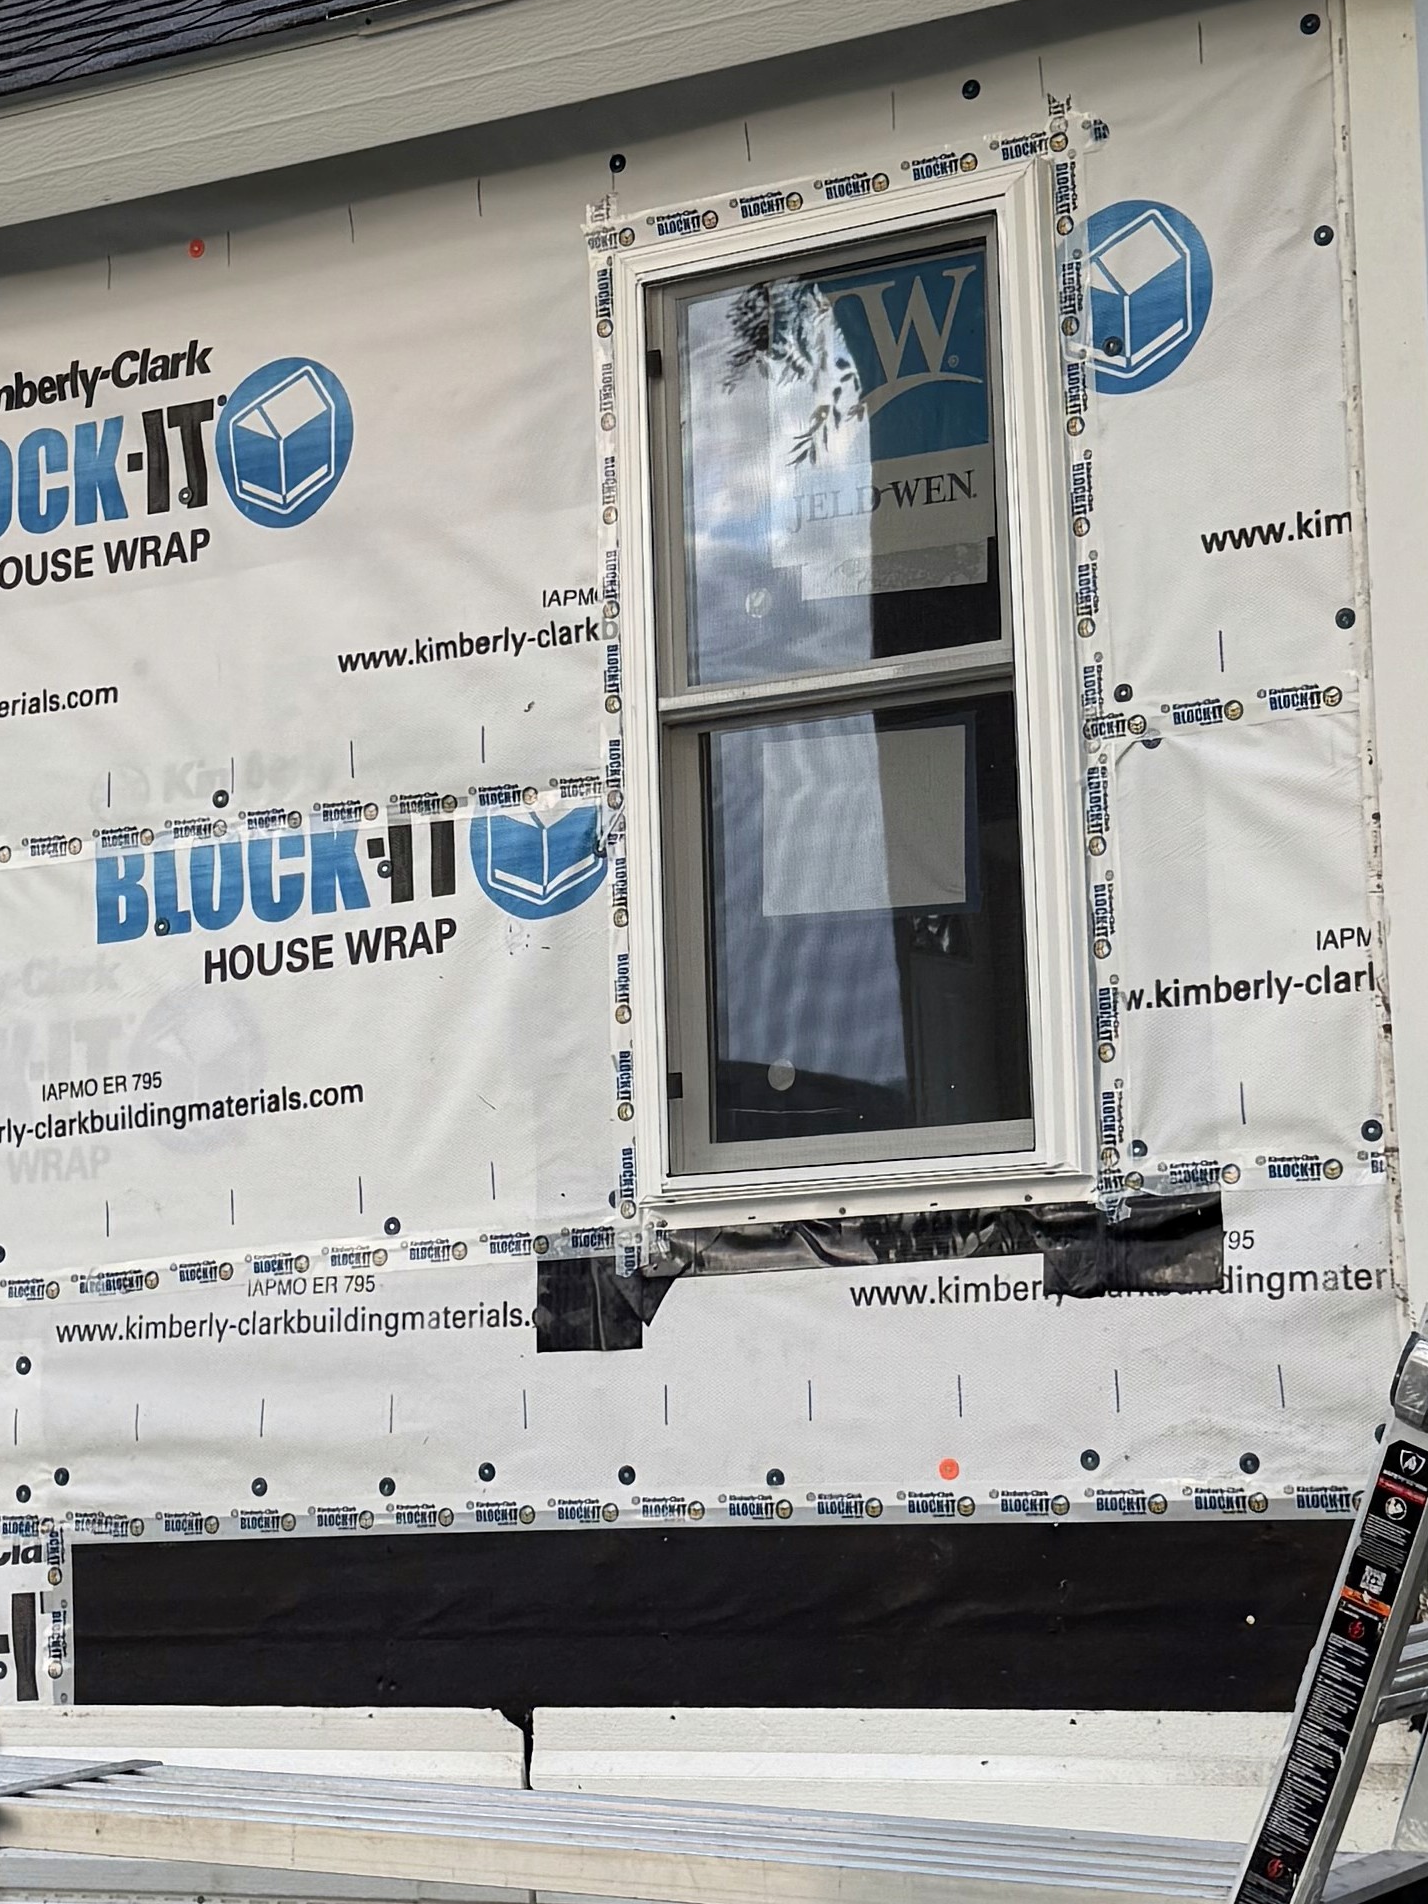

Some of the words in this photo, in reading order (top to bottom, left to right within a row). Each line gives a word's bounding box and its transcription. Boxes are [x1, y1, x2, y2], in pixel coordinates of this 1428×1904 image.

[104, 528, 210, 574] WRAP
[204, 934, 333, 984] HOUSE
[346, 919, 457, 965] WRAP
[42, 1080, 100, 1103] IAPMO
[103, 1075, 129, 1097] ER
[132, 1071, 163, 1093] 795
[247, 1277, 308, 1299] IAPMO
[312, 1274, 340, 1296] ER
[344, 1273, 377, 1295] 795
